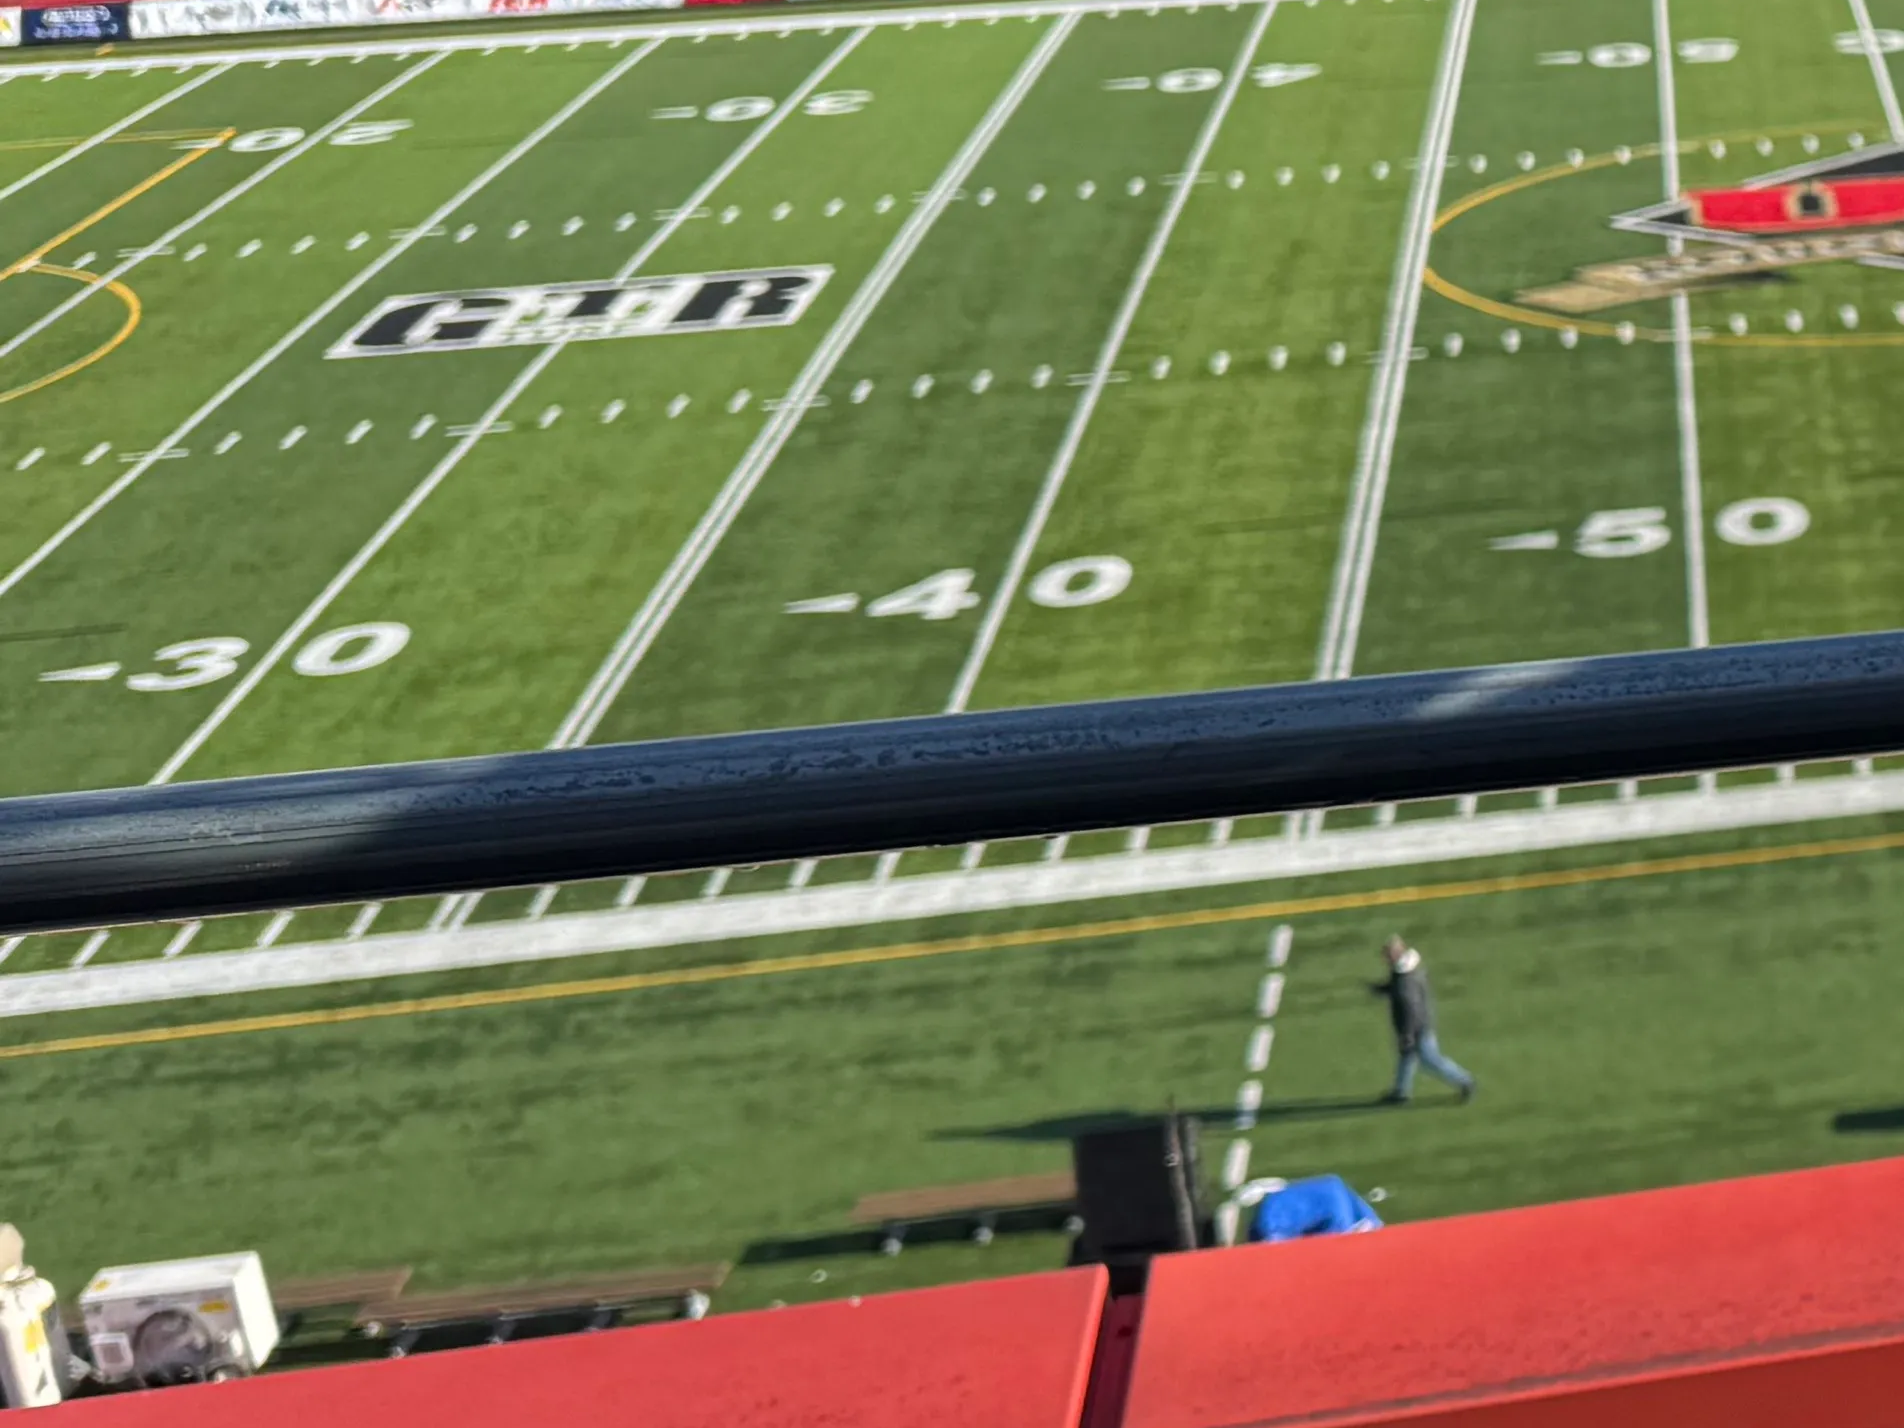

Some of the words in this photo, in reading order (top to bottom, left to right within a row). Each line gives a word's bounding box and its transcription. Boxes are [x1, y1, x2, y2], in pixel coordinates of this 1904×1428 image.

[1571, 493, 1814, 562] 50
[860, 552, 1138, 622] 40
[124, 618, 414, 694] 30
